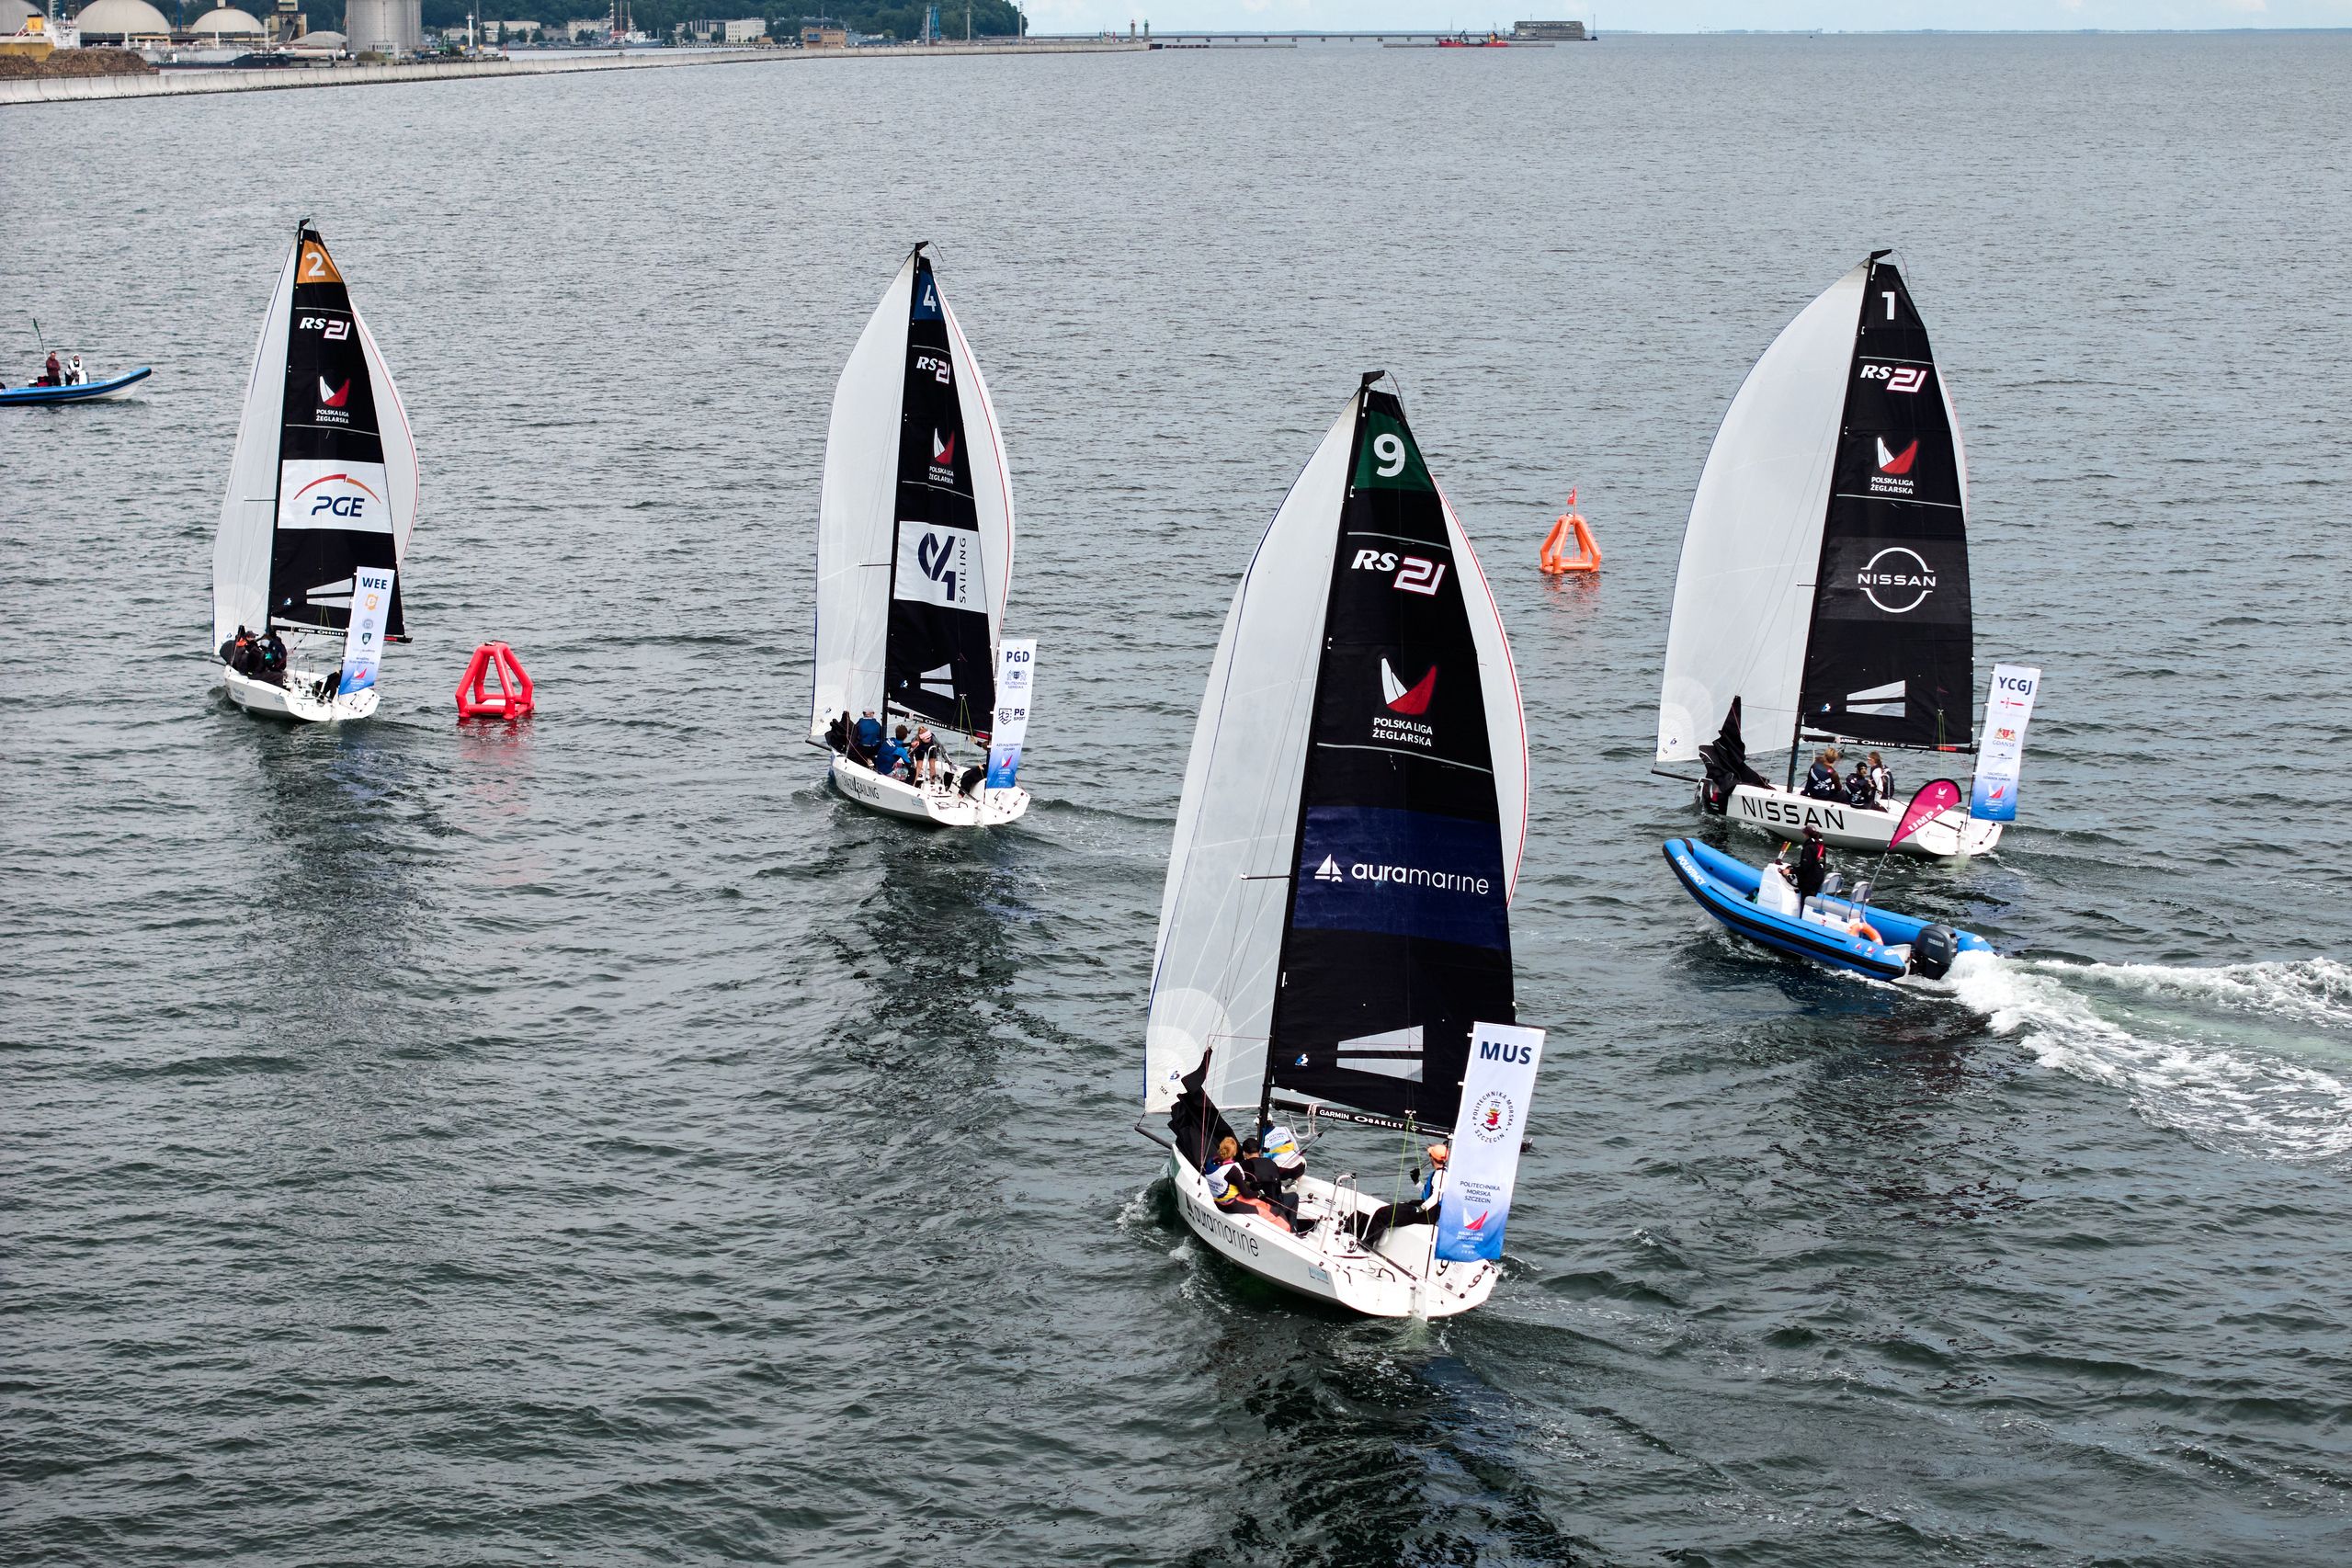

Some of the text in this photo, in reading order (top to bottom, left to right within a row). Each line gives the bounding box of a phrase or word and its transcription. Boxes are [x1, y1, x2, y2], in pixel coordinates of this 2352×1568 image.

[305, 252, 325, 277] 2
[923, 284, 937, 312] 4
[1881, 291, 1895, 321] 1
[300, 316, 351, 341] RS21
[916, 356, 950, 385] RS21
[1860, 364, 1927, 392] RS21
[315, 414, 349, 424] ŻEGLARSKA
[316, 408, 339, 416] POLSKA
[1373, 433, 1406, 478] 9
[929, 465, 947, 474] POLSKA
[1870, 483, 1914, 495] ŻEGLARSKA
[1871, 476, 1915, 487] POLSKA LIGA
[311, 495, 365, 517] PGE
[959, 537, 967, 604] SAILING
[1351, 549, 1447, 597] RS21
[1858, 573, 1937, 587] NISSAN
[362, 576, 388, 590] WEE
[1006, 651, 1030, 663] PGD
[1998, 676, 2033, 696] YCGJ
[1014, 708, 1025, 716] PG
[1373, 717, 1433, 735] POLSKA LIGA
[1372, 727, 1432, 747] ŻEGLARSKA
[1741, 795, 1846, 831] NISSAN
[1907, 811, 1935, 832] UMP
[1350, 862, 1490, 895] auramarine
[1480, 1040, 1533, 1065] MUS
[1319, 1109, 1350, 1120] GARMIN
[1471, 1091, 1515, 1127] POLITECHNIKA MORSKA
[1474, 1129, 1505, 1143] SZCZECIN
[1460, 1180, 1501, 1191] POLITECHNIKA
[1464, 1195, 1492, 1204] SZCZECIN
[1194, 1204, 1259, 1257] auramarine
[1468, 1274, 1482, 1288] 9
